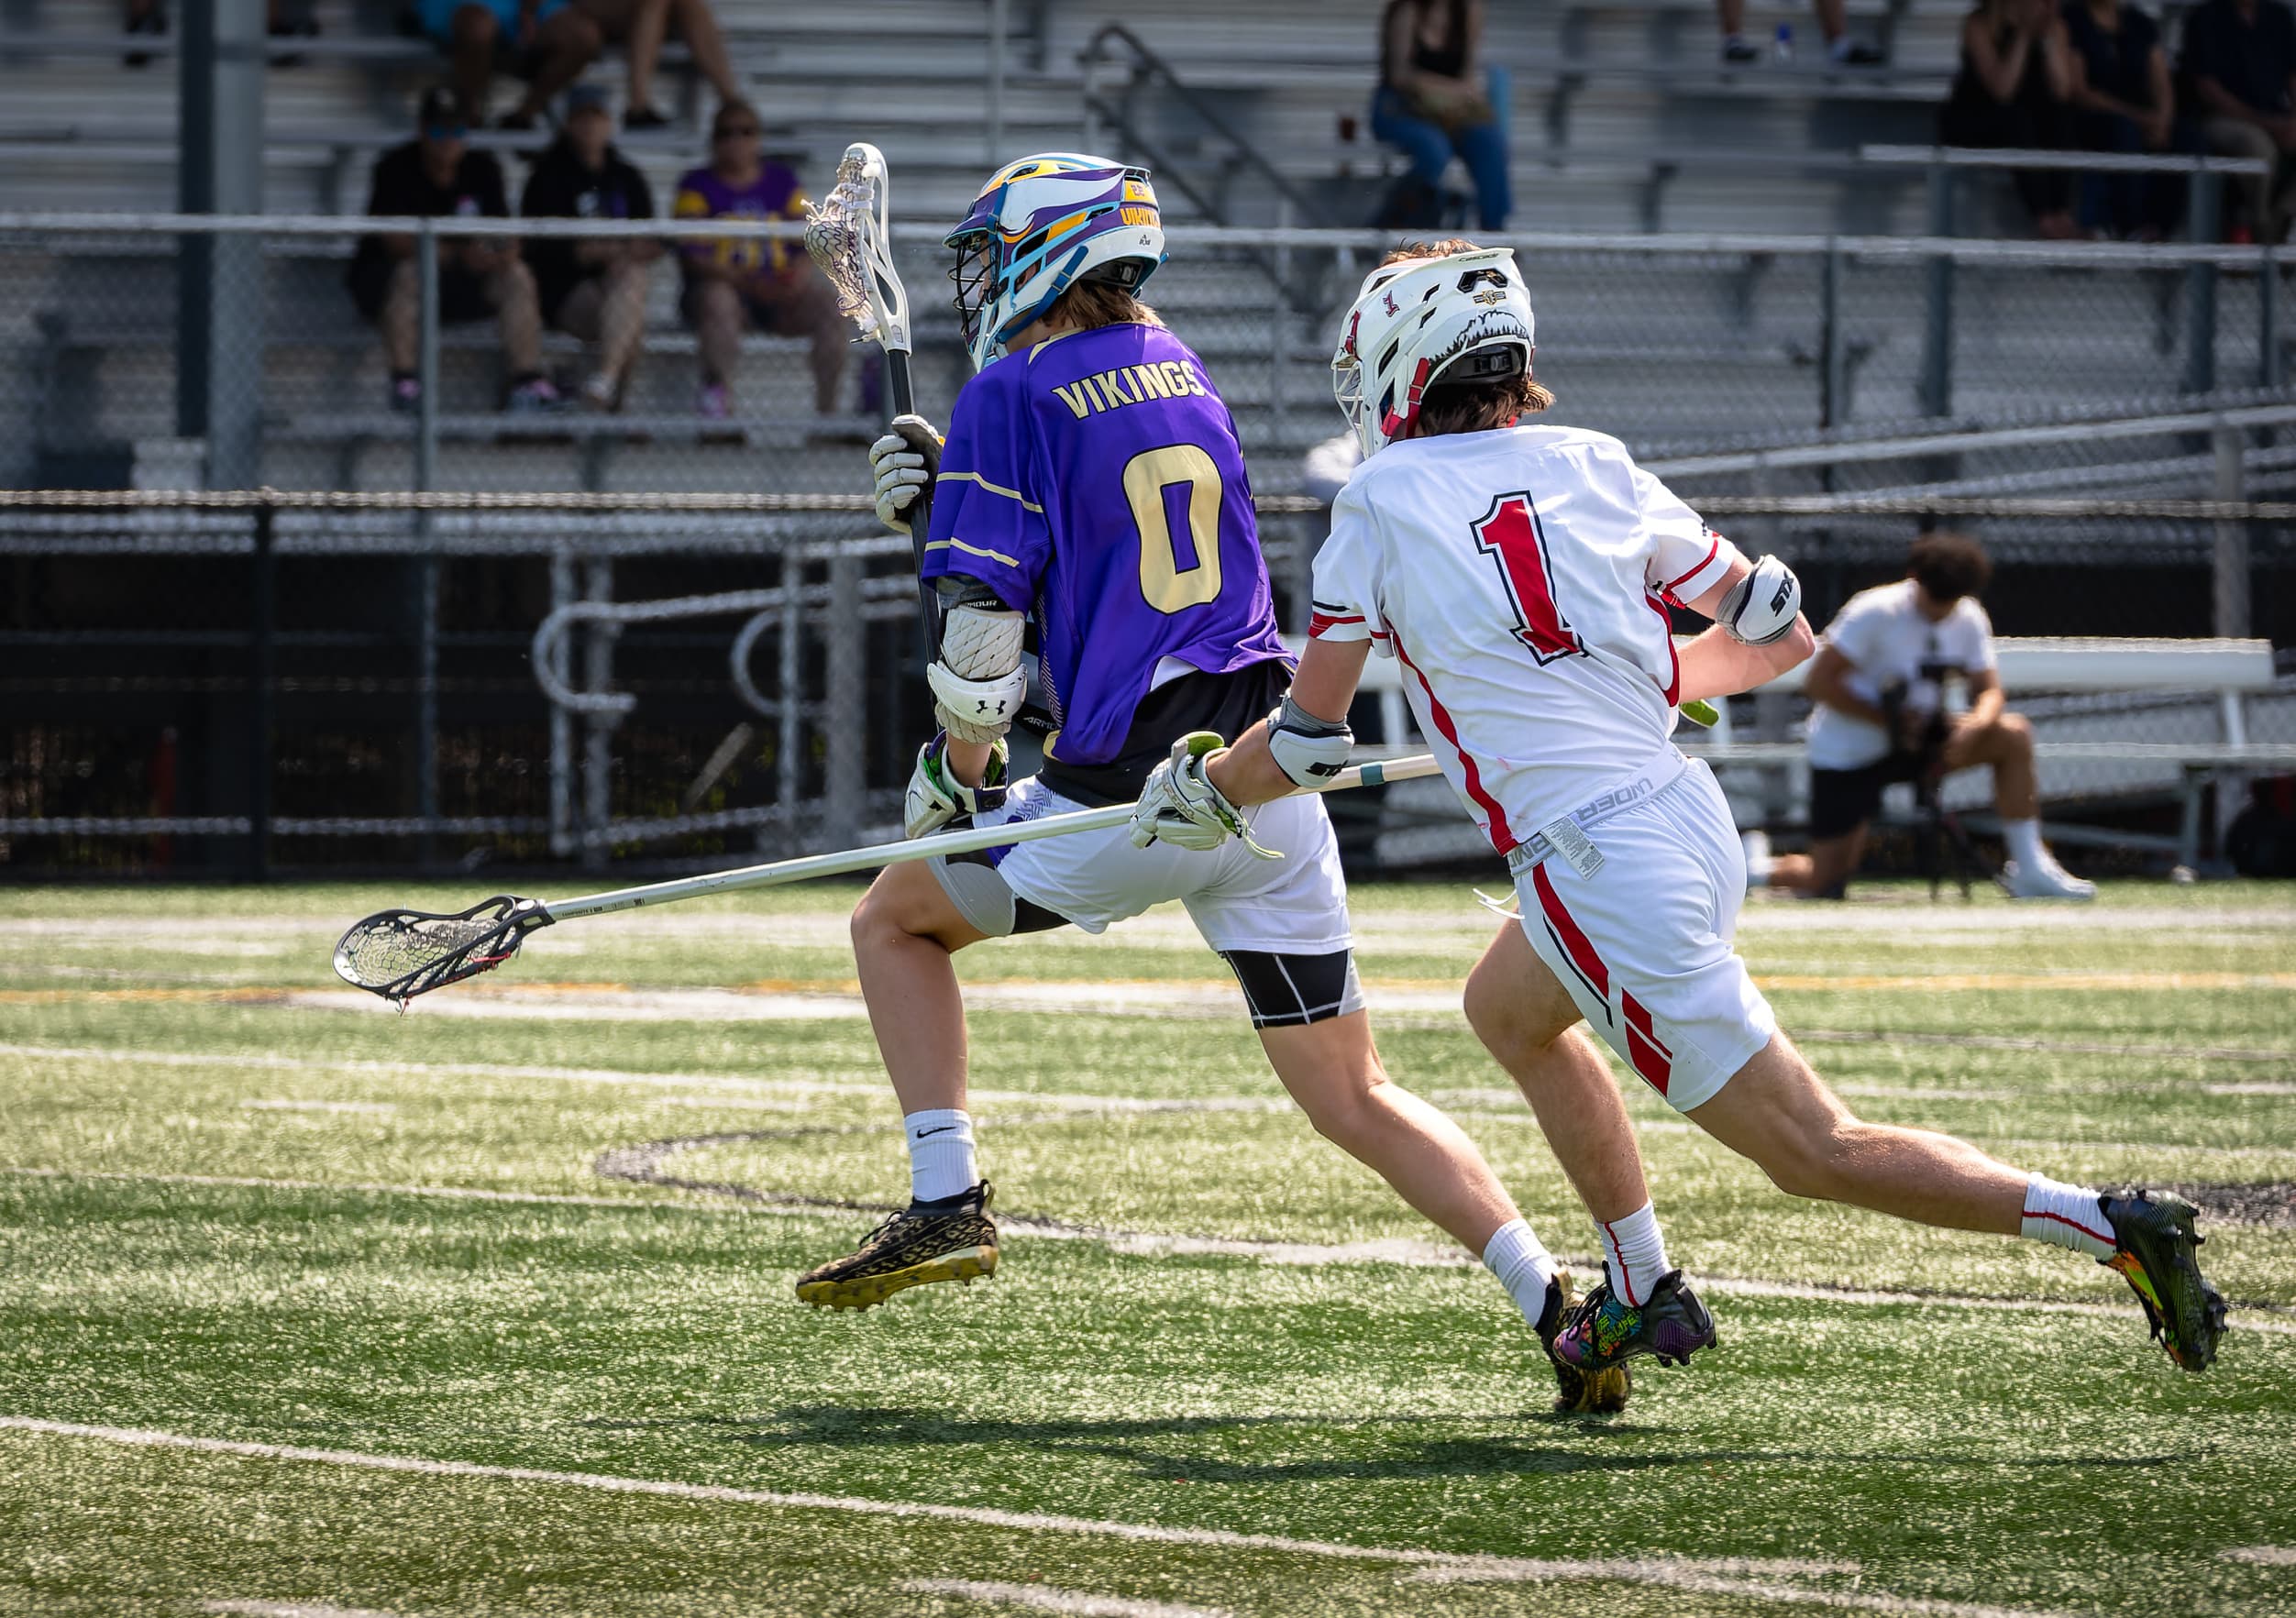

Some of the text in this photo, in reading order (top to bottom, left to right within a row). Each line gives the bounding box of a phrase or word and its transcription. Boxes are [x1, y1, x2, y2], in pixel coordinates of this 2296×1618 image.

[1051, 360, 1206, 420] VIKINGS
[1121, 443, 1223, 616] 0
[1469, 490, 1590, 666] 1
[1576, 778, 1653, 821] UNDER
